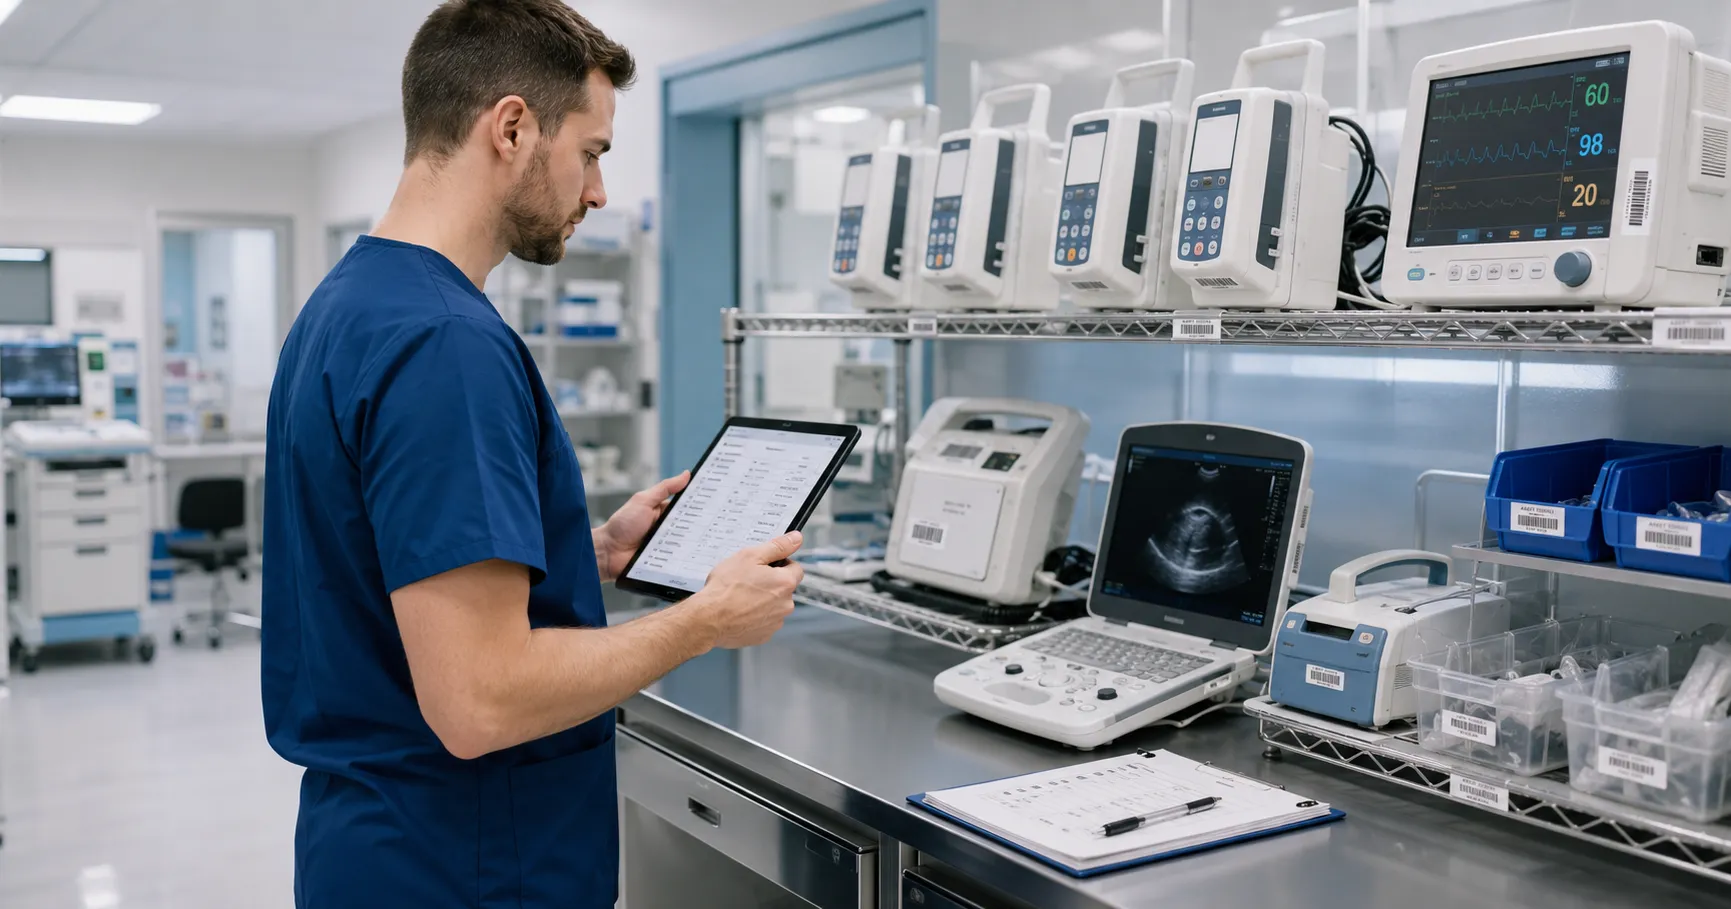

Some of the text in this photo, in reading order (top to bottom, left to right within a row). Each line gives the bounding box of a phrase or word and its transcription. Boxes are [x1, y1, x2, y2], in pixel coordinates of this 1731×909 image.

[1585, 82, 1609, 106] 60
[1579, 133, 1603, 156] 98
[1572, 183, 1597, 207] 20
